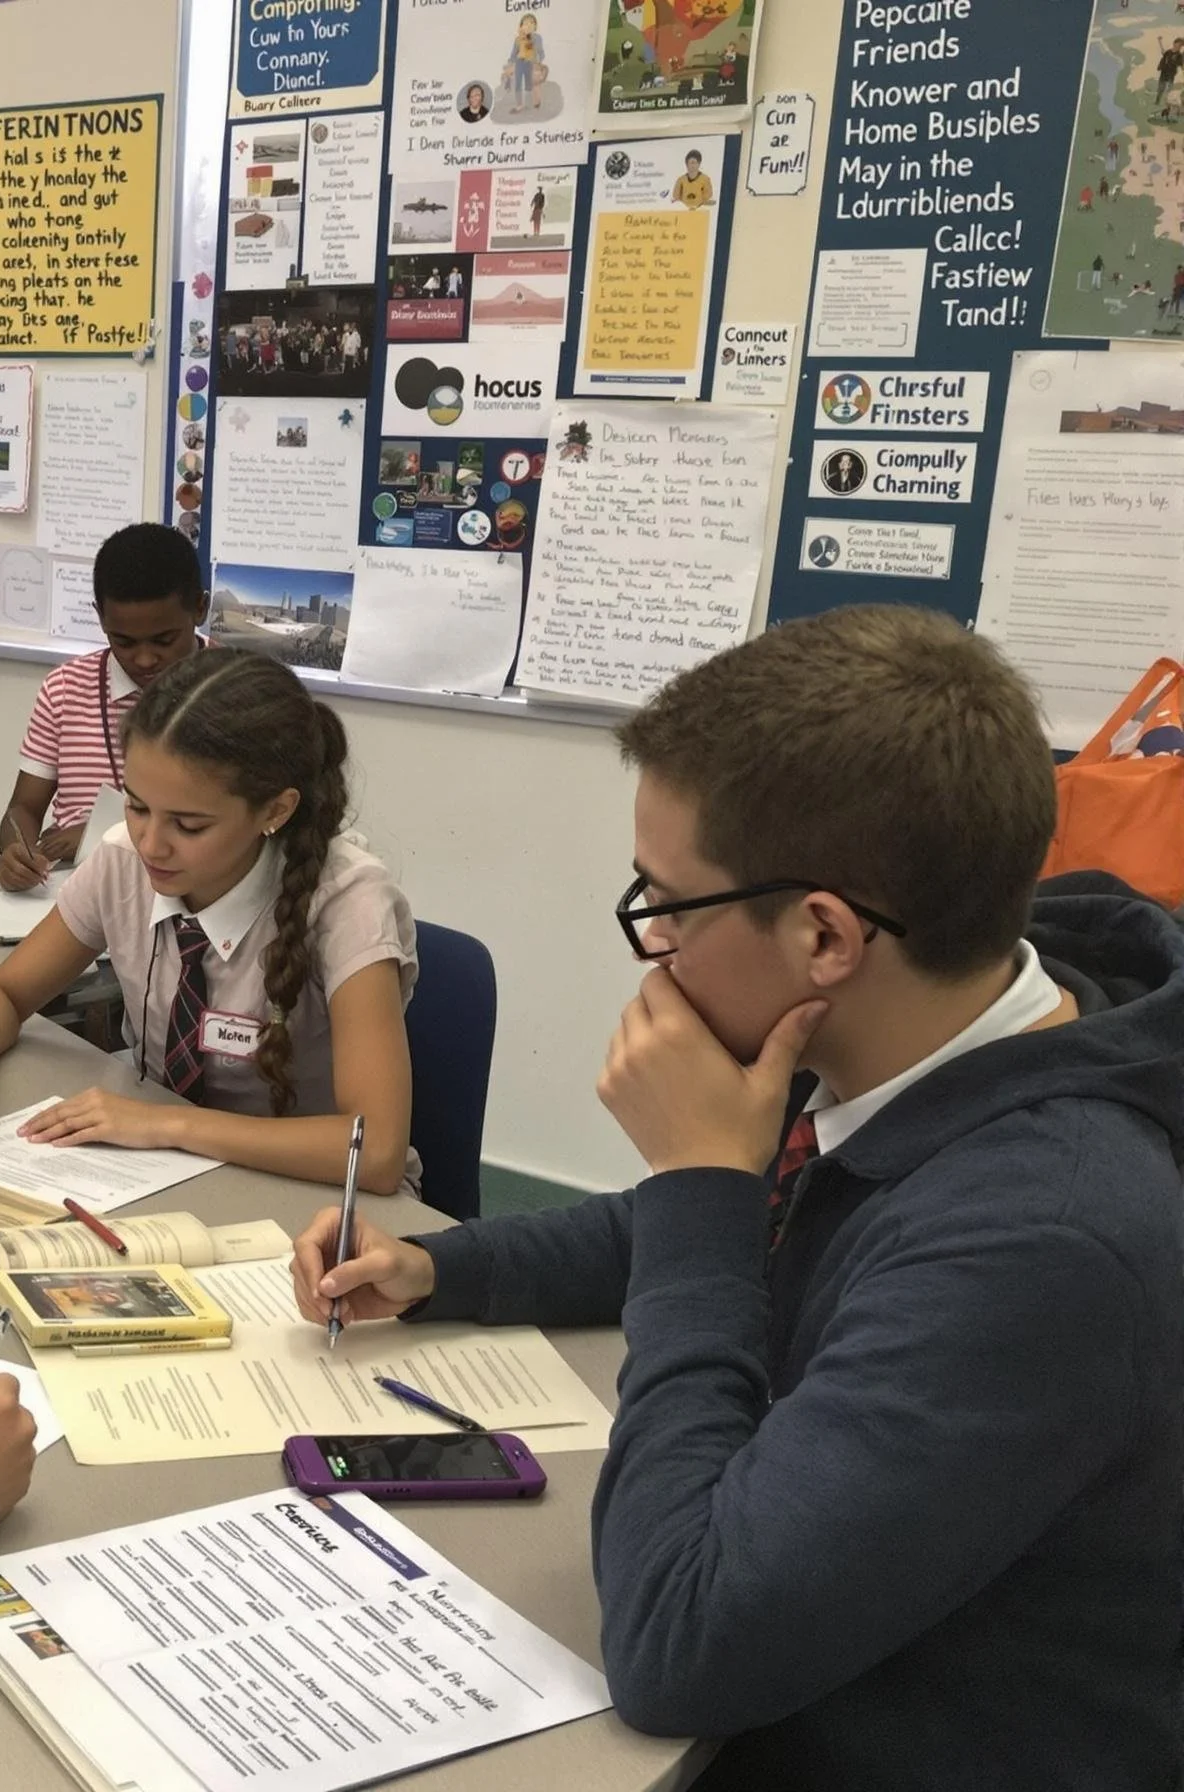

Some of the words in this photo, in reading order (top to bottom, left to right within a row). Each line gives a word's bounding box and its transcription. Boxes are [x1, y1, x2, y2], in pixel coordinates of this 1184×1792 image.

[852, 28, 960, 67] Friends
[850, 78, 957, 108] Knower
[967, 66, 1021, 100] and
[844, 117, 917, 145] Home
[0, 169, 27, 189] the
[101, 163, 129, 184] the
[837, 156, 892, 190] May
[899, 155, 921, 181] in
[930, 149, 974, 178] the
[59, 188, 88, 208] and
[7, 211, 37, 229] who
[97, 269, 123, 288] the
[473, 374, 543, 399] hocus
